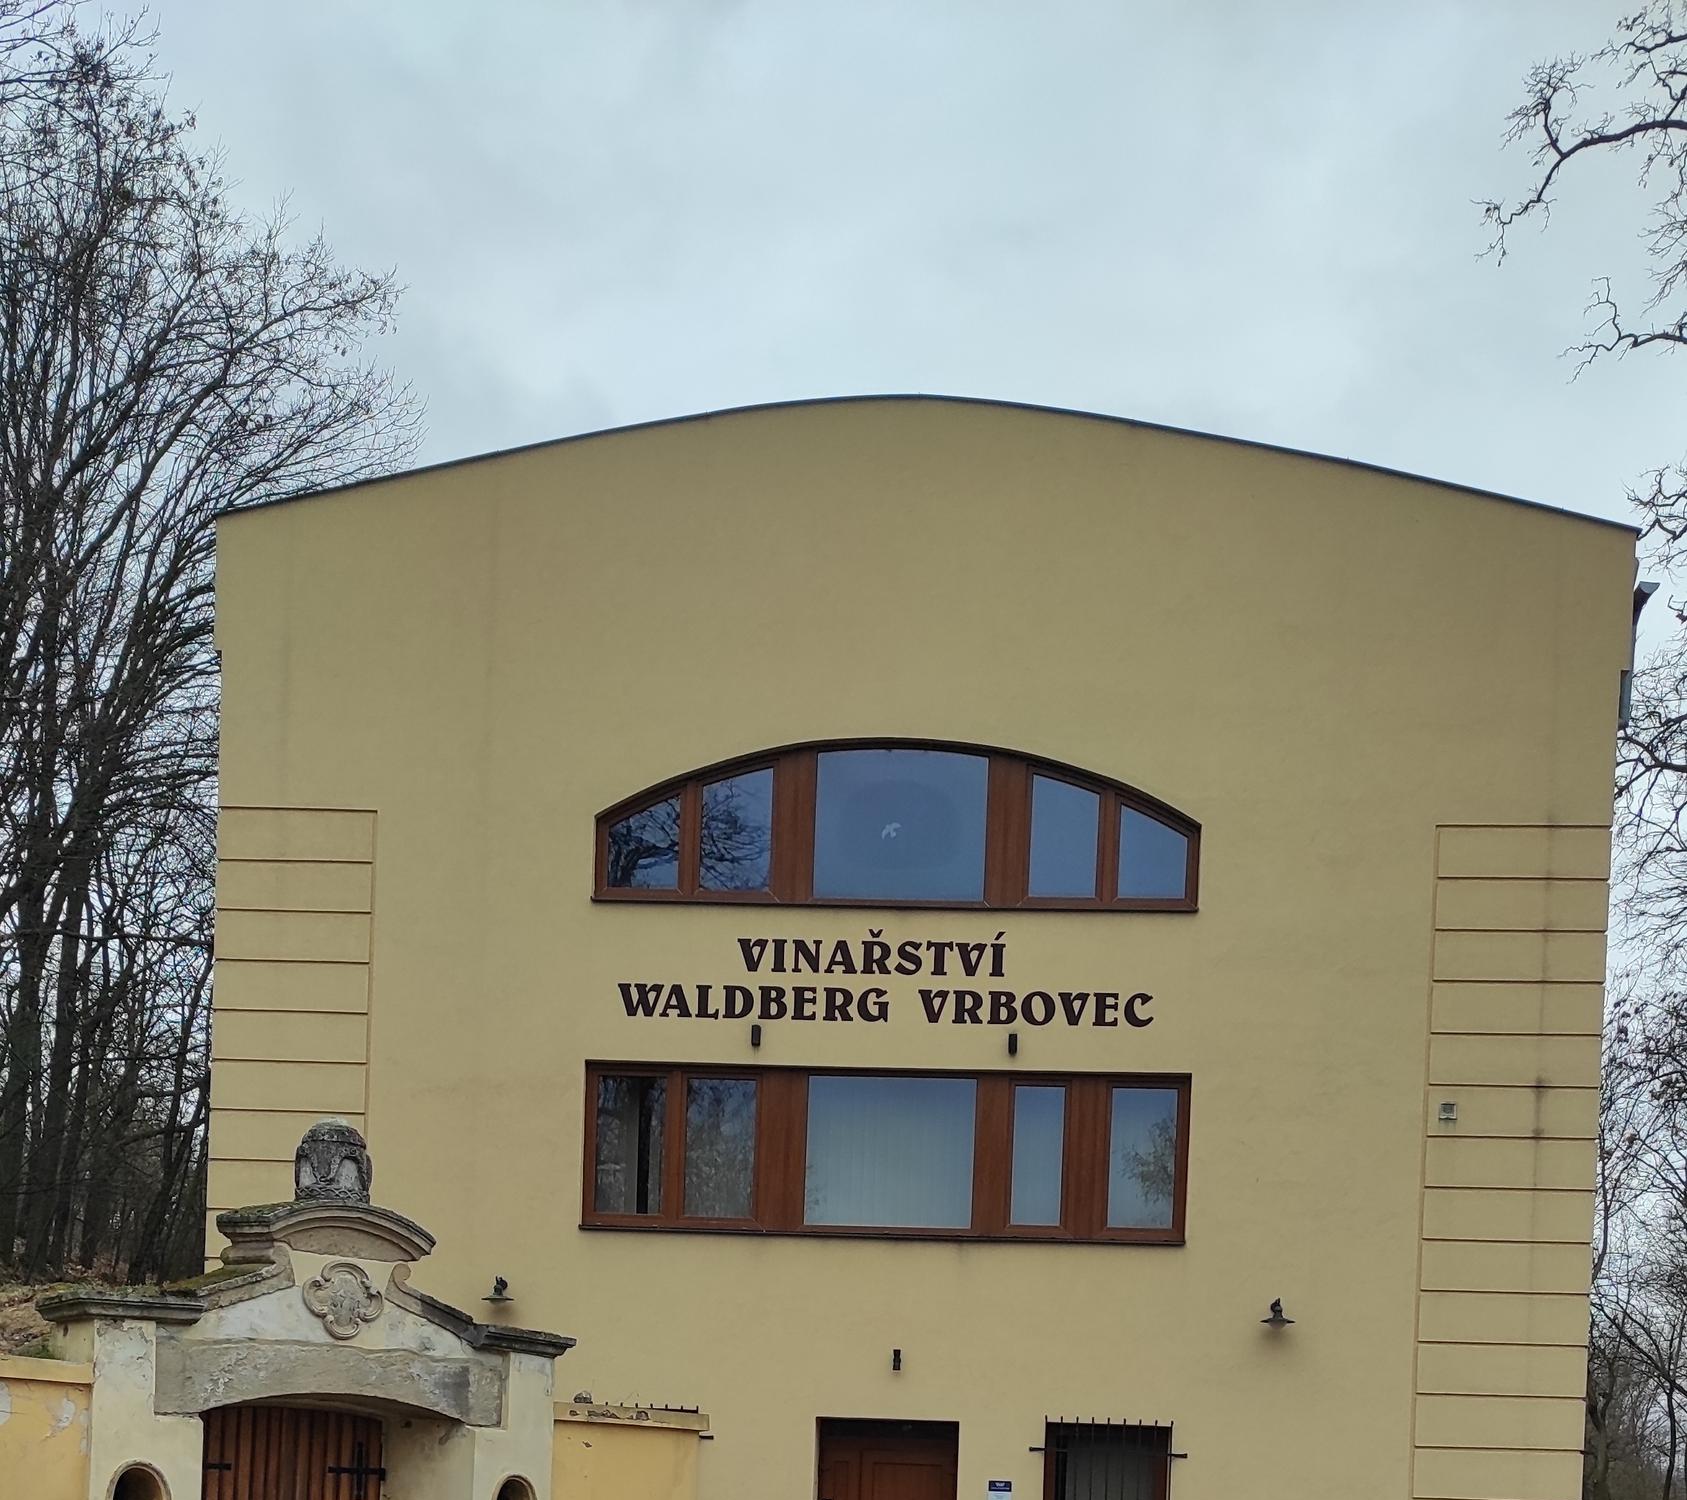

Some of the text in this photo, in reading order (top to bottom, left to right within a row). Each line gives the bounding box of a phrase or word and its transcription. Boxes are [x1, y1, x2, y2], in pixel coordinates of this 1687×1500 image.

[737, 928, 1007, 978] VINAŘSTVÍ
[617, 982, 1155, 1028] WALDBERG VRBOVEC
